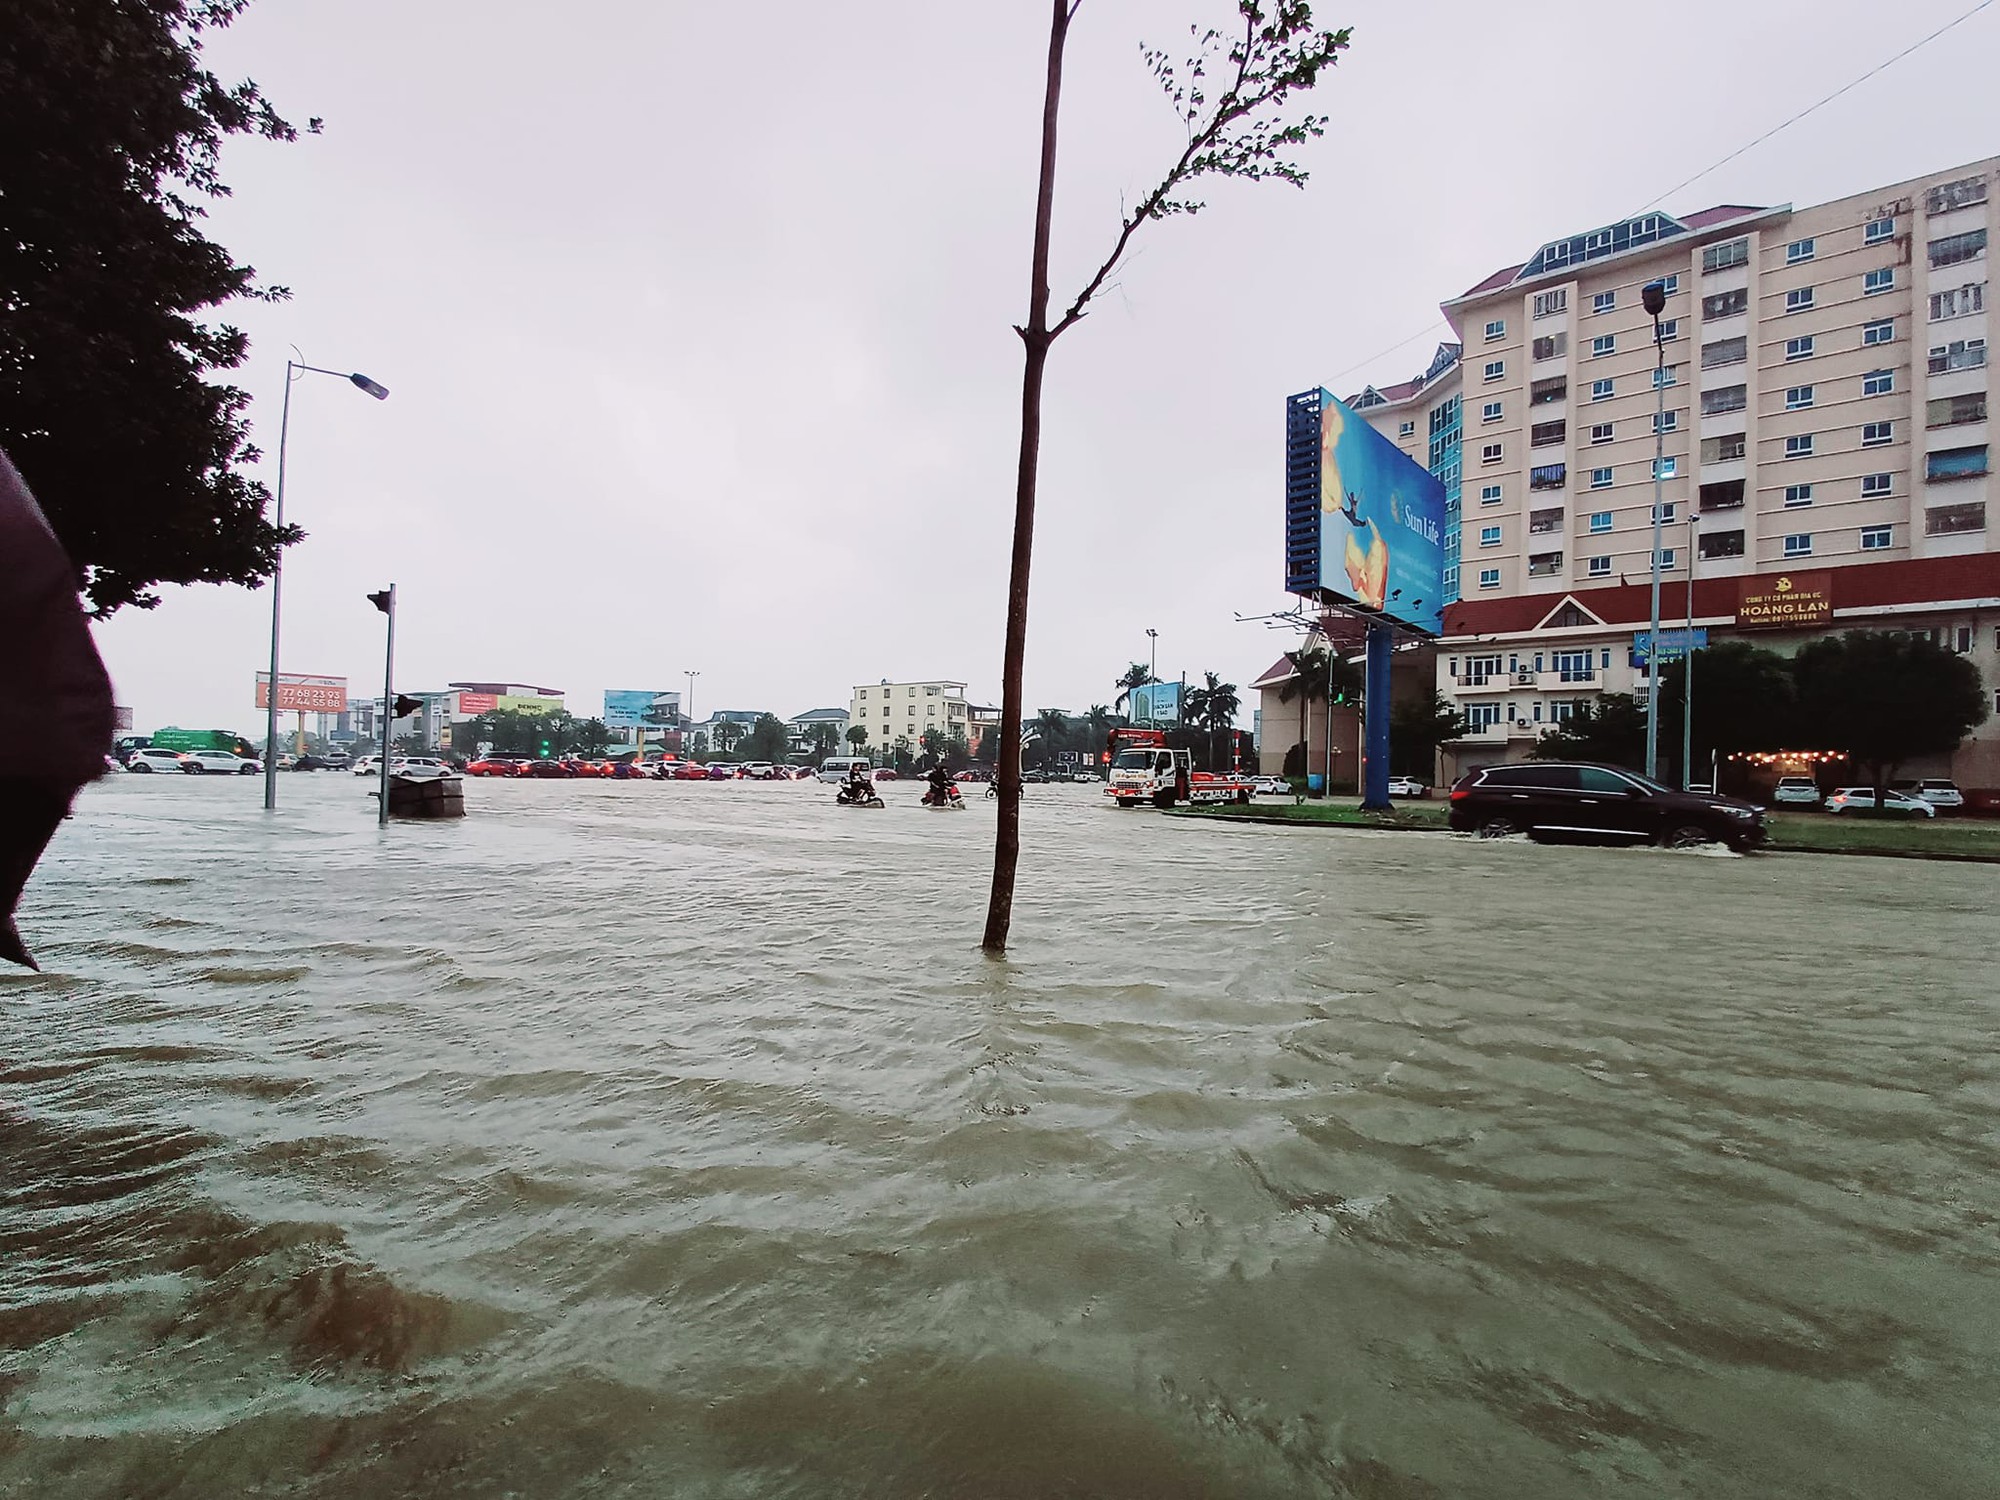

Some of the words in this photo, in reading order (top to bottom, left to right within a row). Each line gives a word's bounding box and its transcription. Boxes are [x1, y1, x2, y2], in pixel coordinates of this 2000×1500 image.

[1404, 504, 1423, 535] Sun
[1423, 516, 1440, 546] Life
[1740, 603, 1794, 616] HOÀNG
[1797, 602, 1829, 613] LAN
[282, 688, 295, 696] 77
[297, 688, 310, 698] 68
[312, 690, 325, 698] 23
[327, 691, 340, 699] 93
[282, 697, 294, 705] 77
[296, 698, 310, 706] 44
[312, 699, 326, 707] 55
[327, 699, 340, 707] 88
